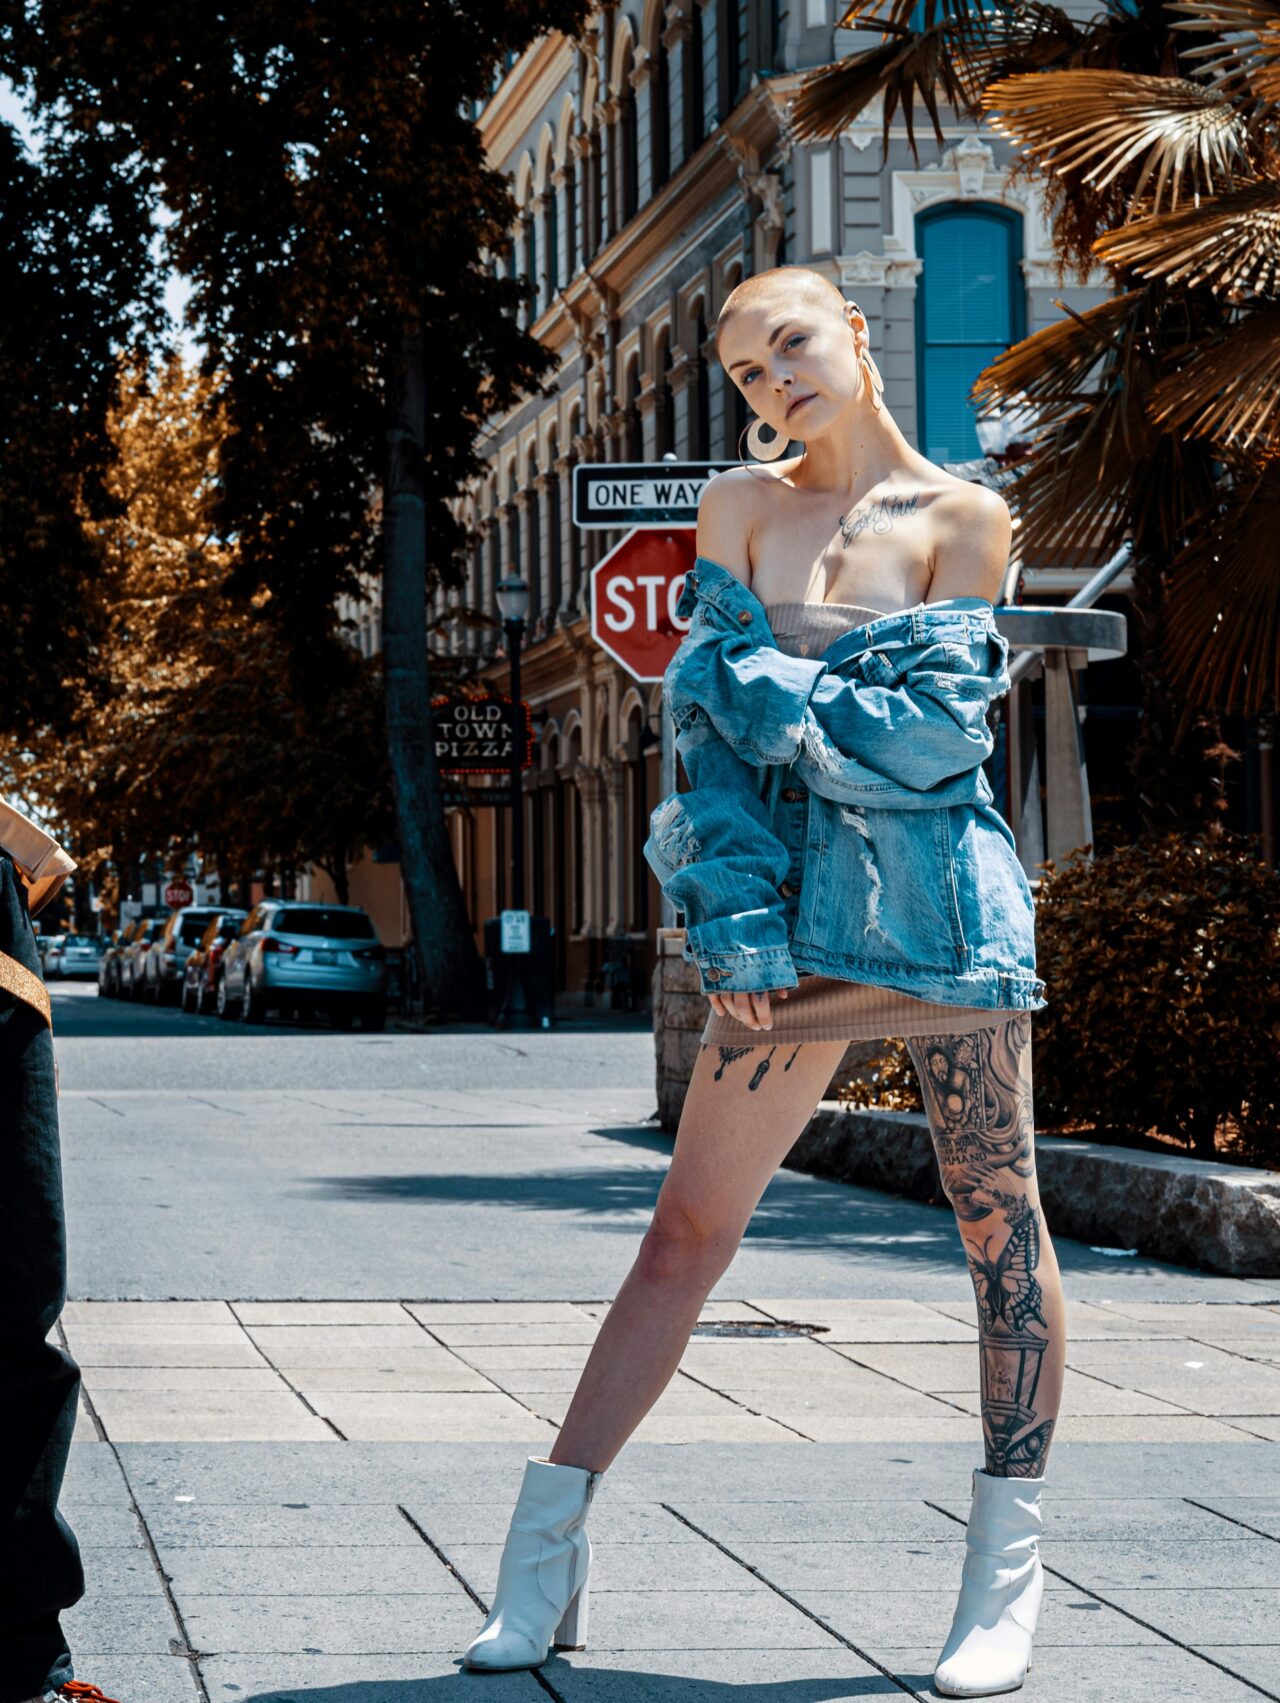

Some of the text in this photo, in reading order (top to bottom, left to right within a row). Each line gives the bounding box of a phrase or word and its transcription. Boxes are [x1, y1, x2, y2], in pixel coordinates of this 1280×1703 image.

[595, 482, 703, 506] ONE WAY
[604, 575, 692, 632] STO
[454, 705, 502, 721] OLD
[437, 722, 513, 739] TOWN
